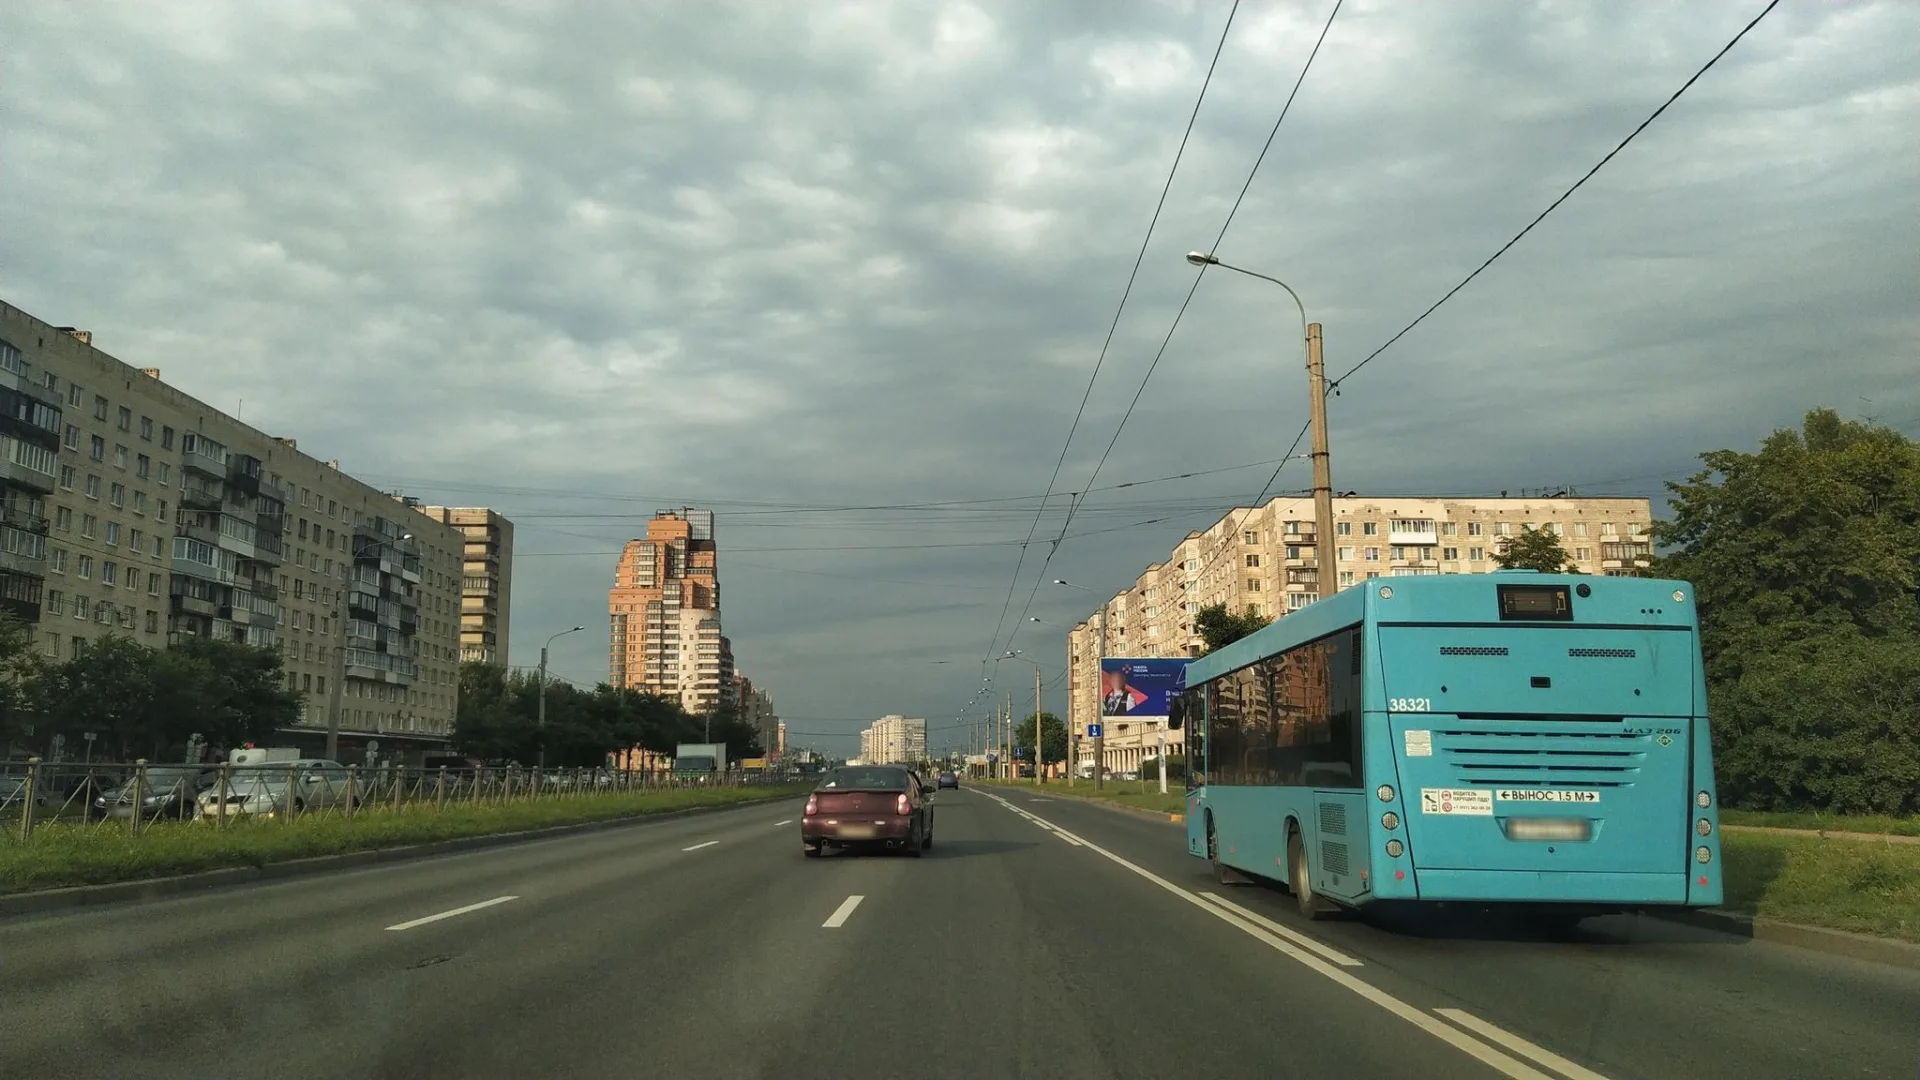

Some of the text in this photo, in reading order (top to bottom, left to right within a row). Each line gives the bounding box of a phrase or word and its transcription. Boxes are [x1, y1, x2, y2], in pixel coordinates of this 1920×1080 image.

[1390, 697, 1430, 711] 38321
[1511, 790, 1554, 800] ВЫНОС
[1557, 791, 1571, 801] 1.5
